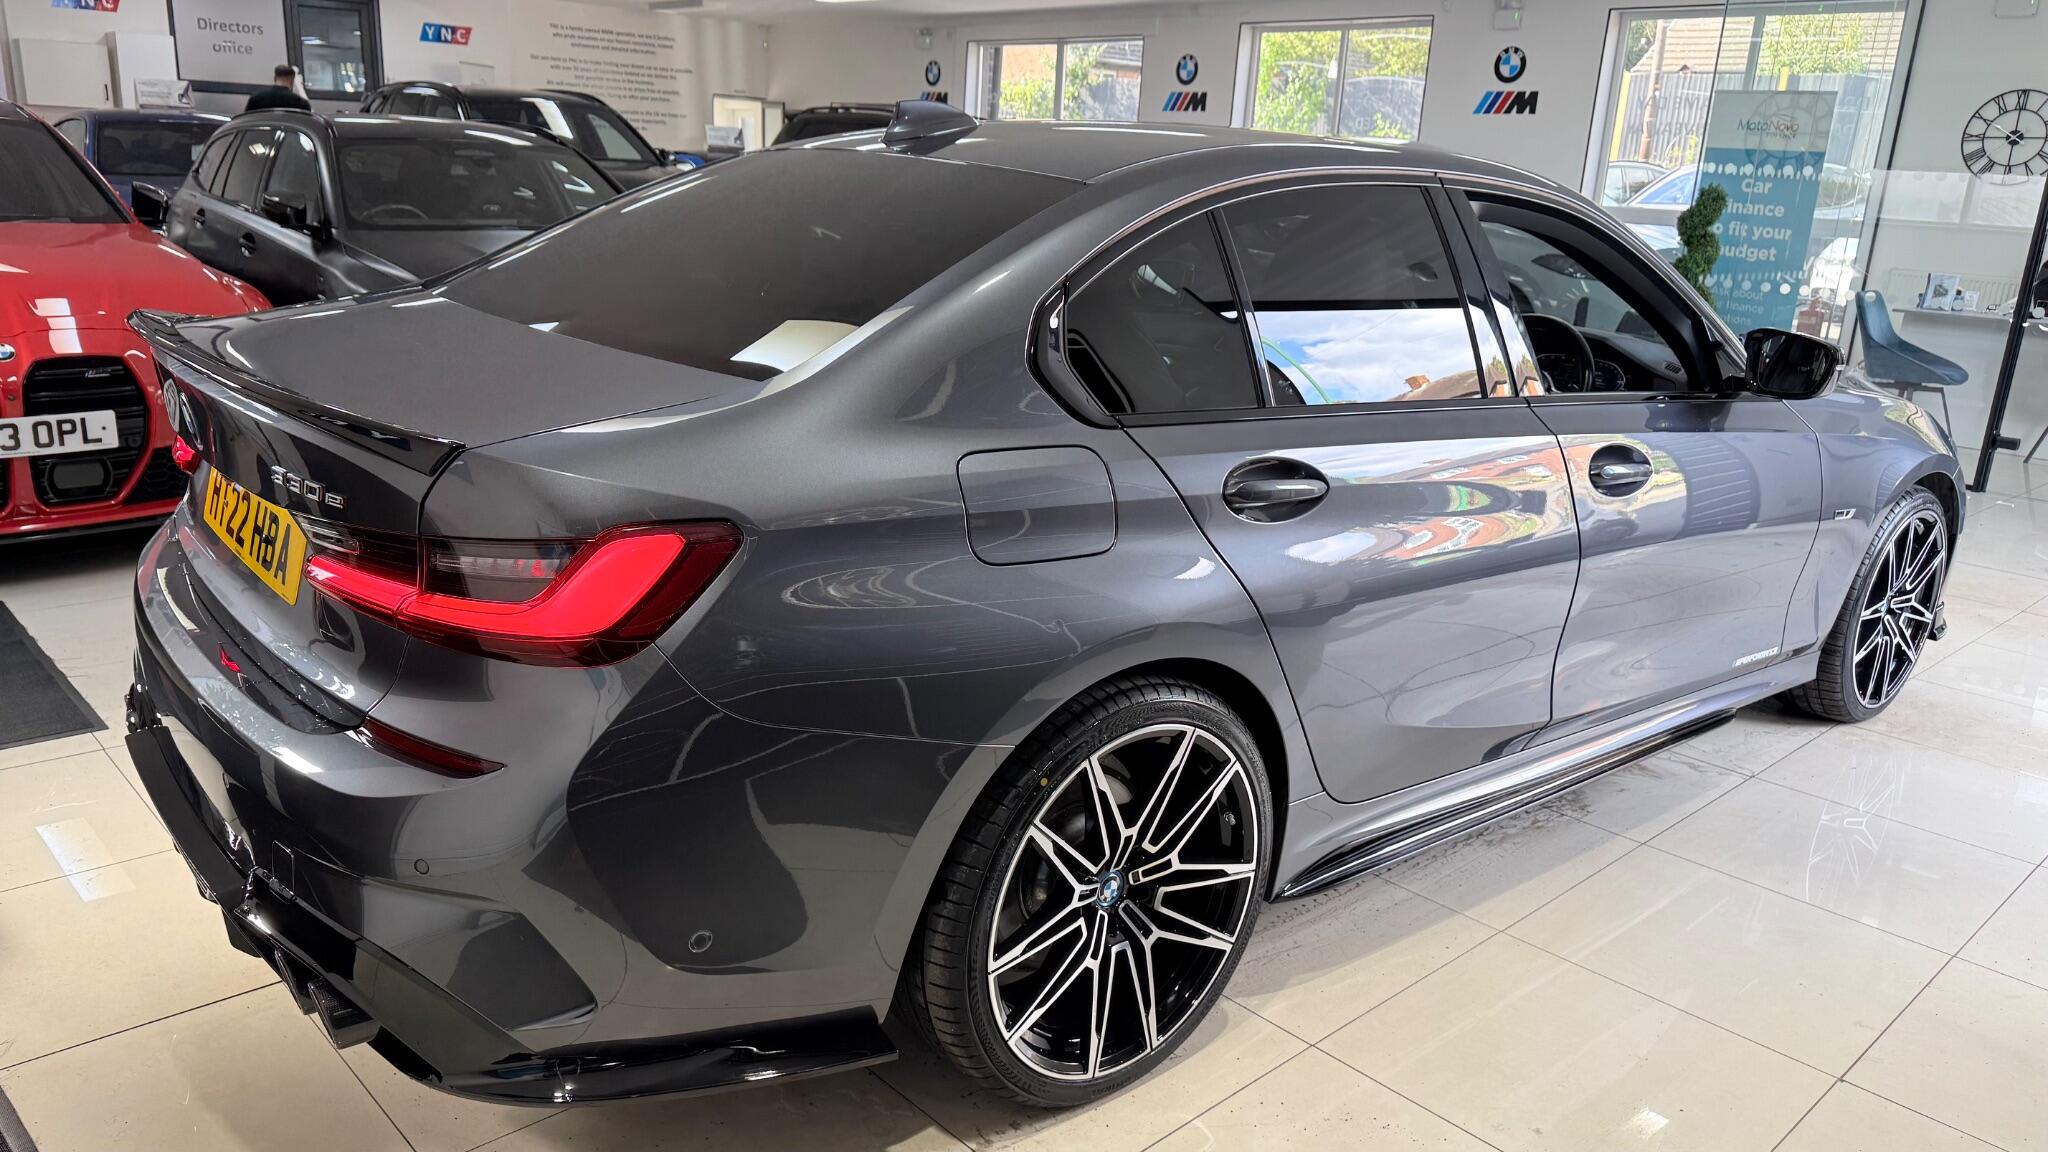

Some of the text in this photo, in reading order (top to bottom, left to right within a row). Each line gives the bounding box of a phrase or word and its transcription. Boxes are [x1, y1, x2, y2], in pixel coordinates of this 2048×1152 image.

[197, 17, 263, 35] Directors
[212, 40, 253, 55] office
[1737, 118, 1800, 133] MotoNovo
[1741, 178, 1773, 194] Car
[1723, 200, 1785, 217] inance
[1728, 221, 1748, 237] fit
[1752, 227, 1792, 241] your
[1733, 287, 1764, 300] about
[32, 417, 103, 448] OPL
[271, 466, 345, 510] 330e
[249, 502, 291, 586] HBA
